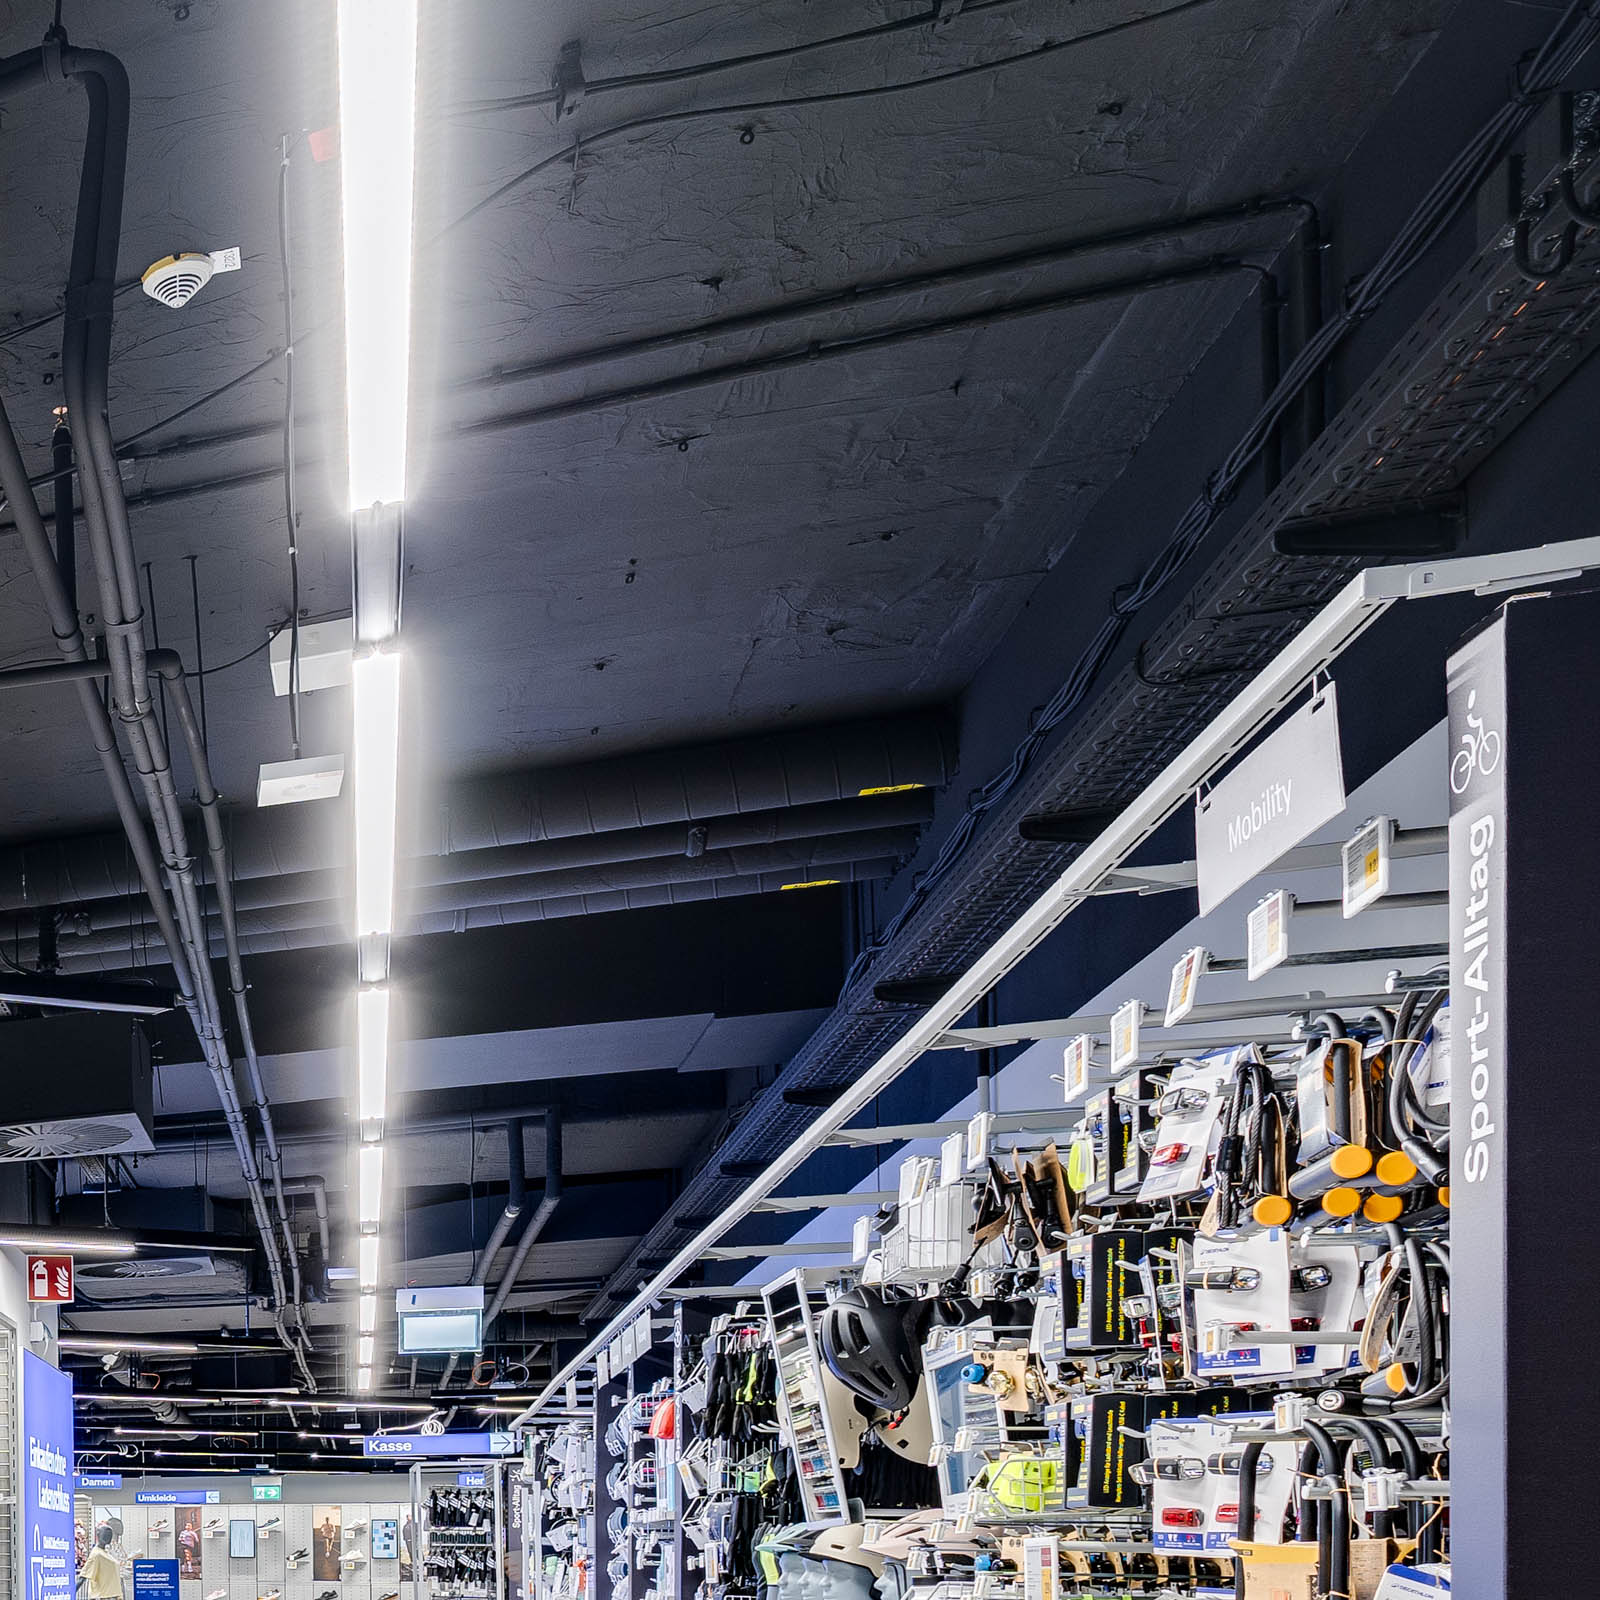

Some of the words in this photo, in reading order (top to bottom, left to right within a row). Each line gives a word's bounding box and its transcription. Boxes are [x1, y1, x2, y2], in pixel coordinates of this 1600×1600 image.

[1227, 777, 1292, 853] Mobility
[1463, 814, 1495, 1183] Sport-Alltag
[368, 1439, 412, 1453] Kasse
[81, 1478, 115, 1487] Damen
[466, 1476, 485, 1485] Her
[137, 1494, 177, 1502] Umkleide
[511, 1485, 521, 1529] Sport-Alltag
